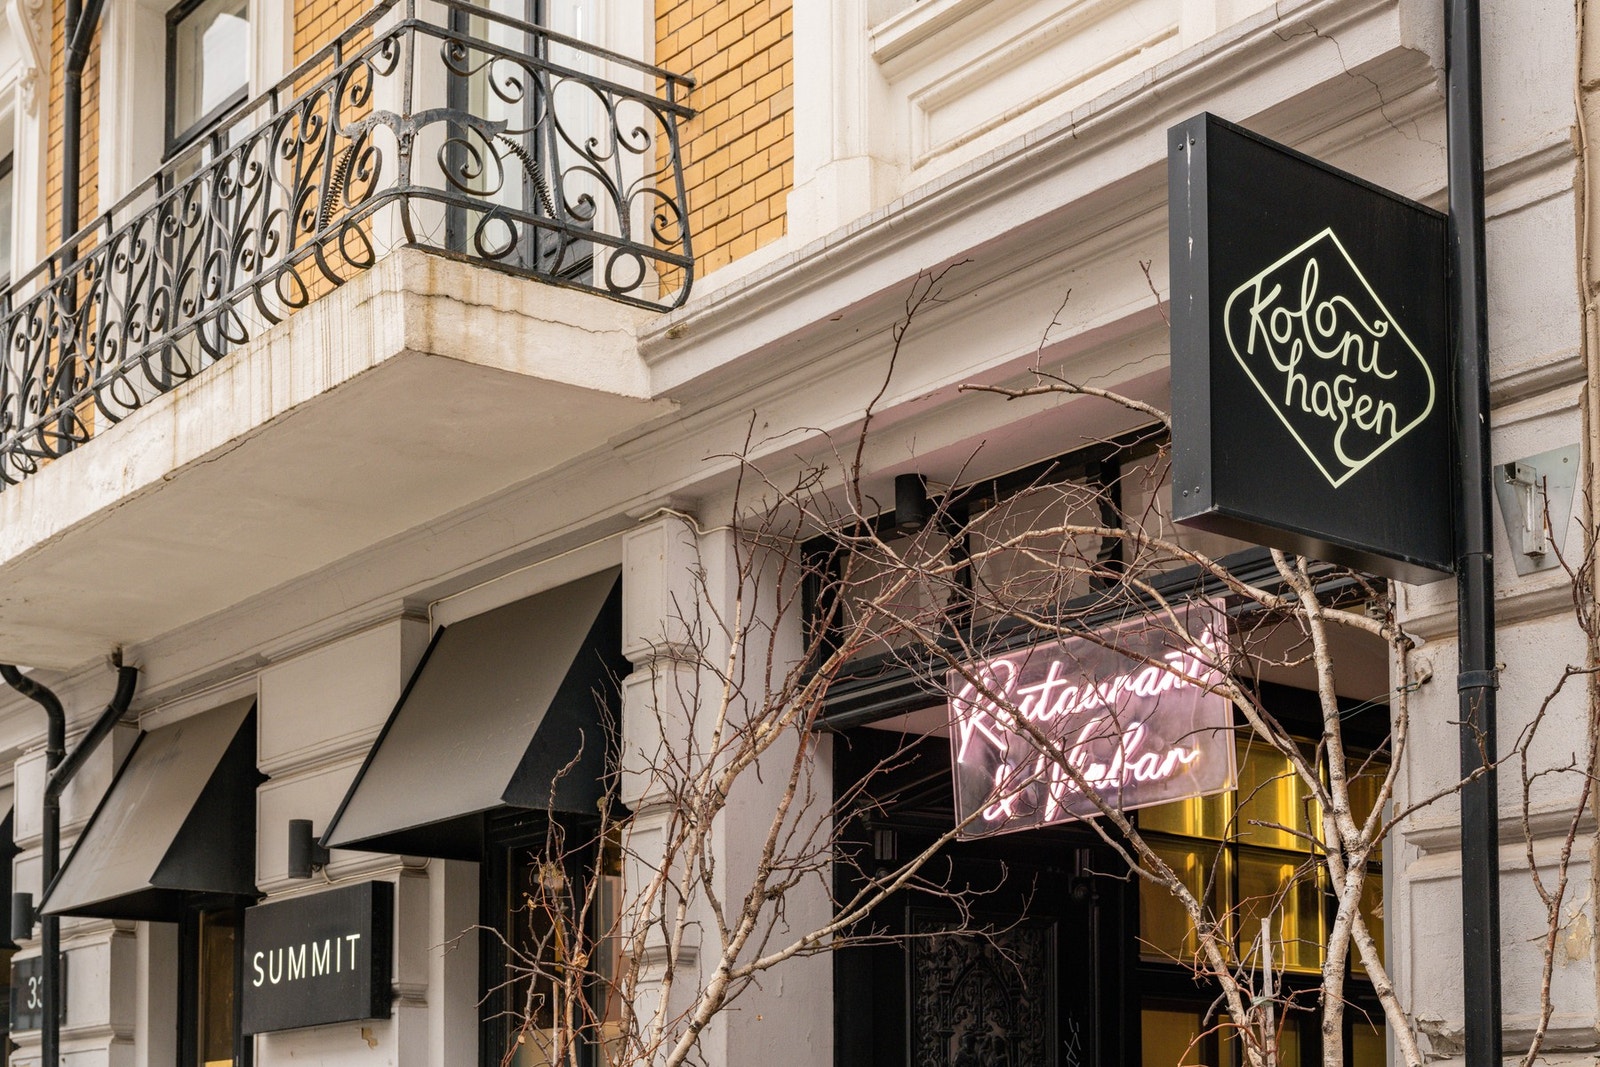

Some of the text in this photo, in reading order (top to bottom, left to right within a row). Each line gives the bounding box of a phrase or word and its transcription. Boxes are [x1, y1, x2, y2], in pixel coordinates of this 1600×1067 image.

[1247, 258, 1397, 379] Koloni
[1285, 338, 1400, 468] hagen
[253, 934, 360, 987] SUMMIT
